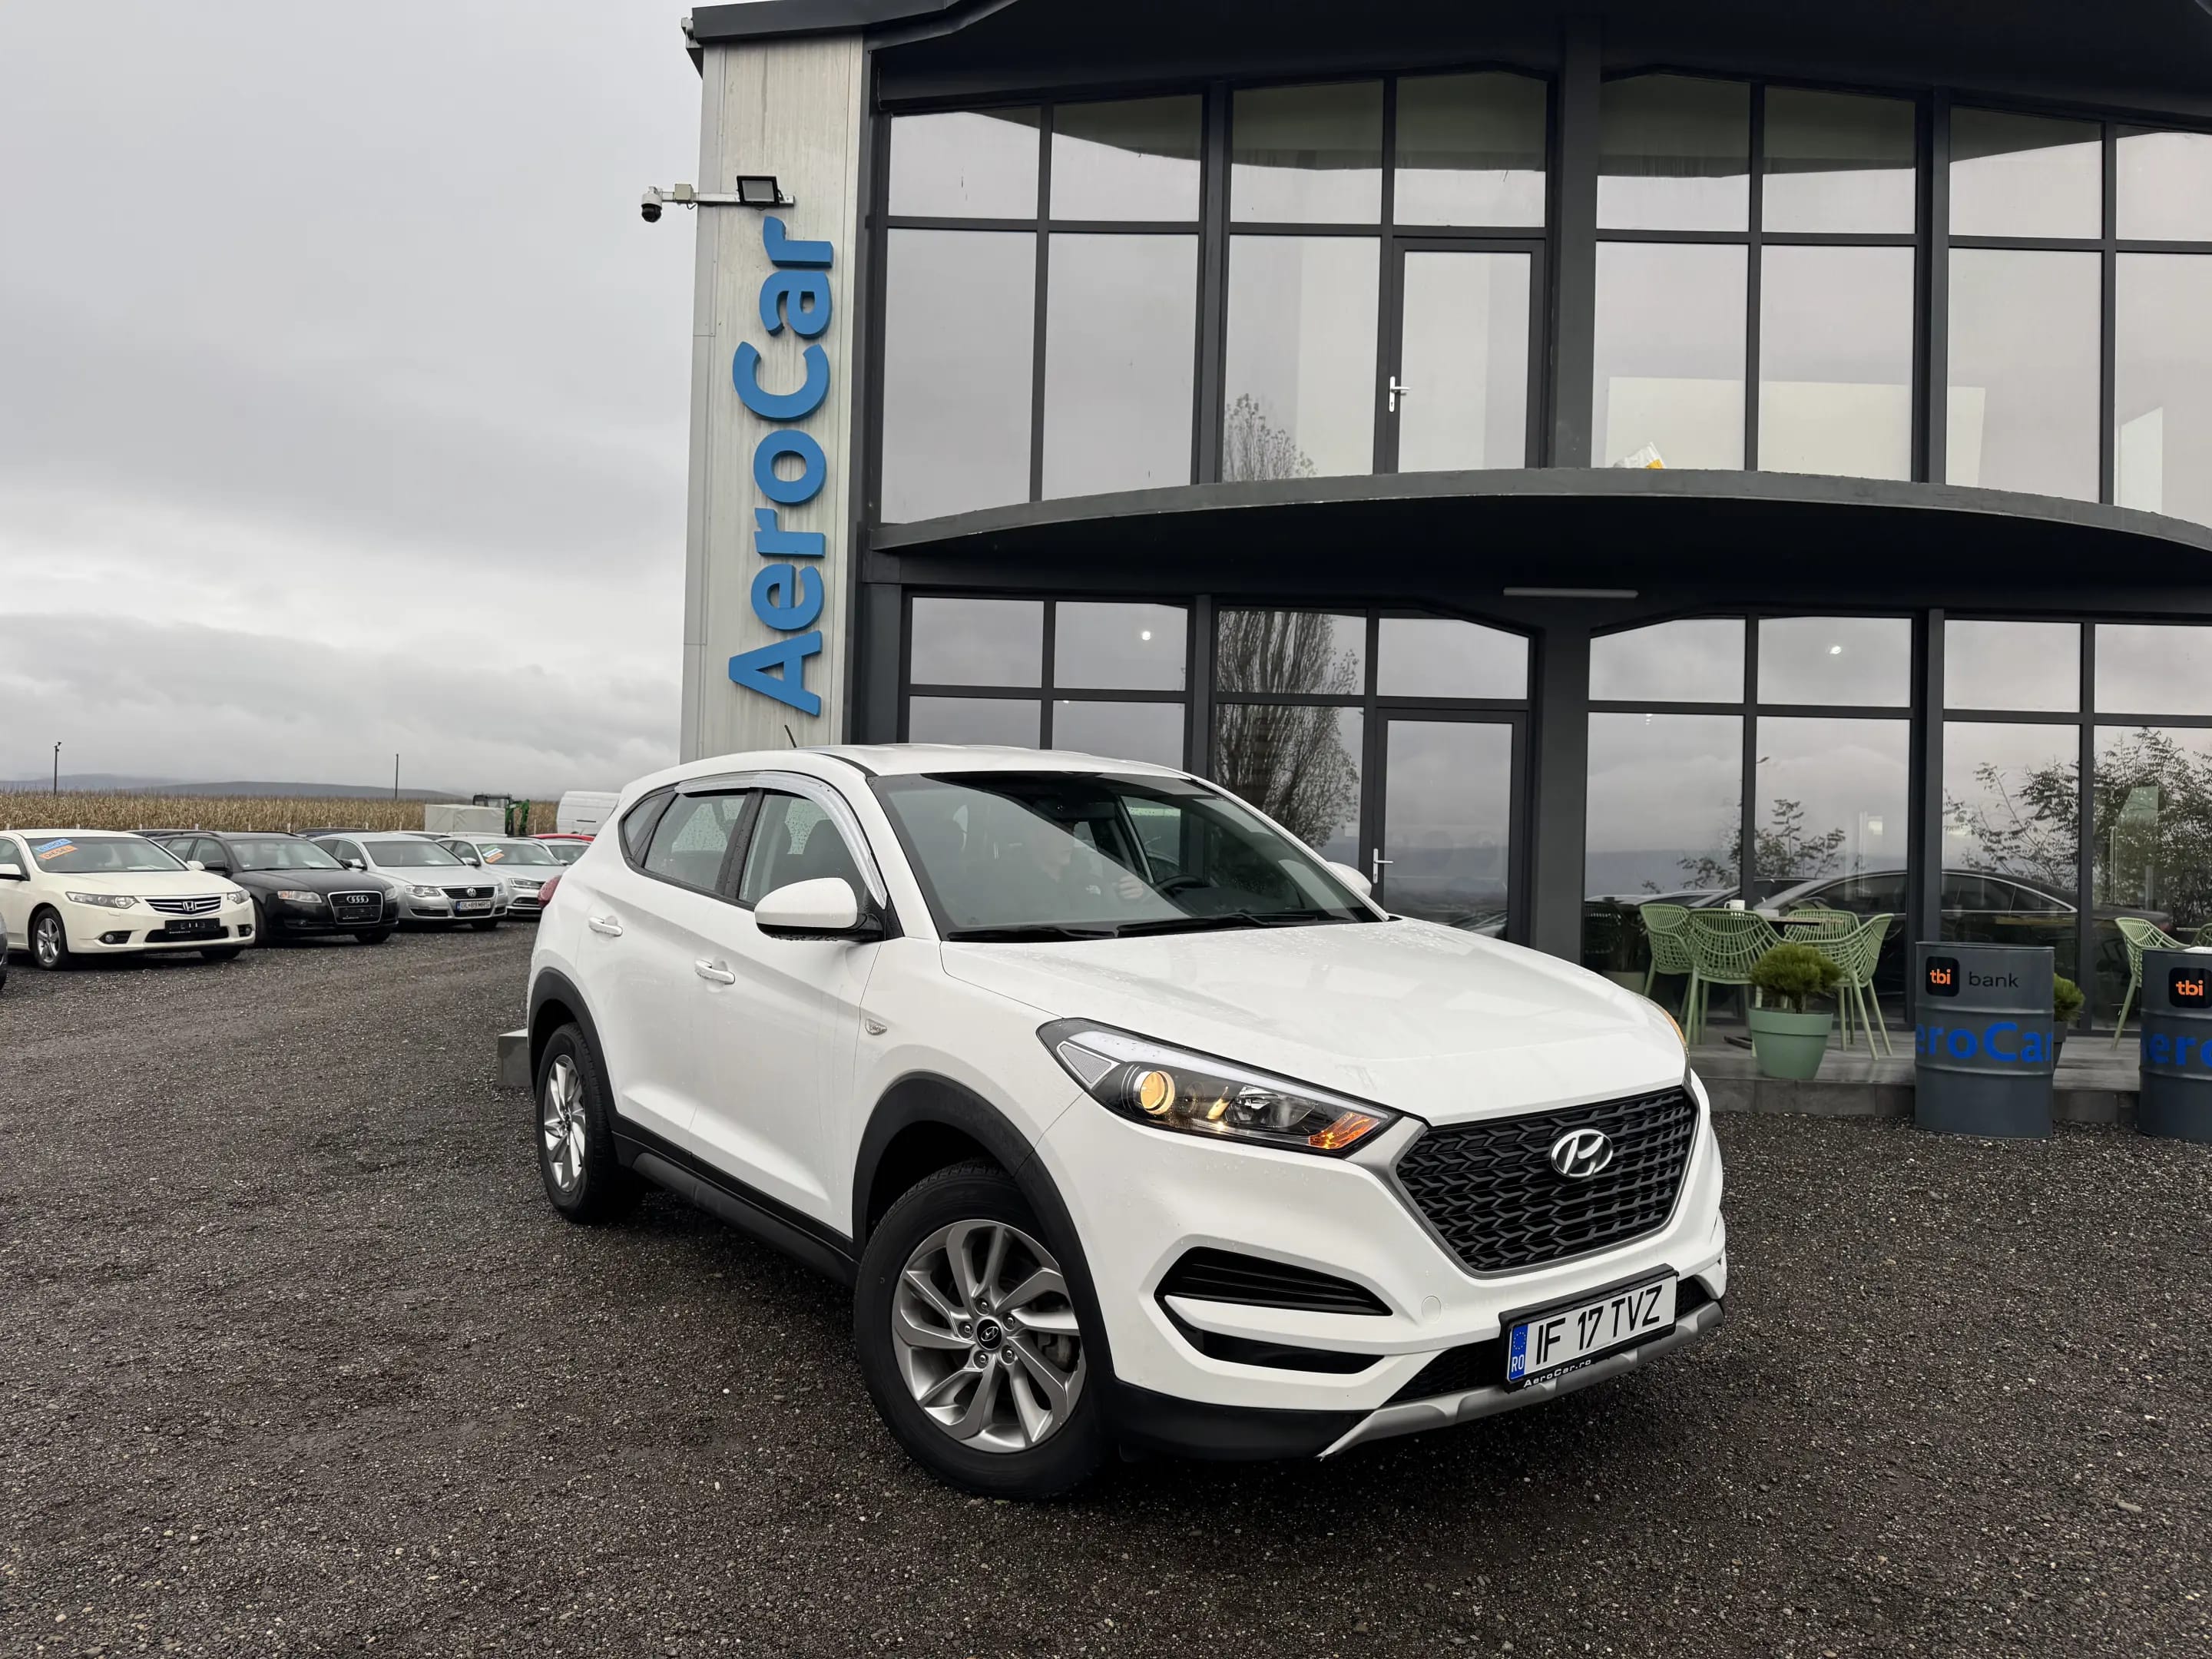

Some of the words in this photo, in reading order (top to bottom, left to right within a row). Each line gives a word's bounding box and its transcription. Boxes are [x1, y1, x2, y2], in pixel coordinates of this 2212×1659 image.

[727, 216, 834, 717] AeroCar
[1930, 969, 1952, 985] tbi
[1969, 971, 2018, 988] bank
[2175, 979, 2204, 997] tbi
[1535, 1317, 1566, 1365] IF
[1578, 1306, 1604, 1351] 17
[1611, 1284, 1663, 1338] TVZ
[1511, 1354, 1525, 1373] RO
[1523, 1359, 1592, 1389] AeroCar.ro
